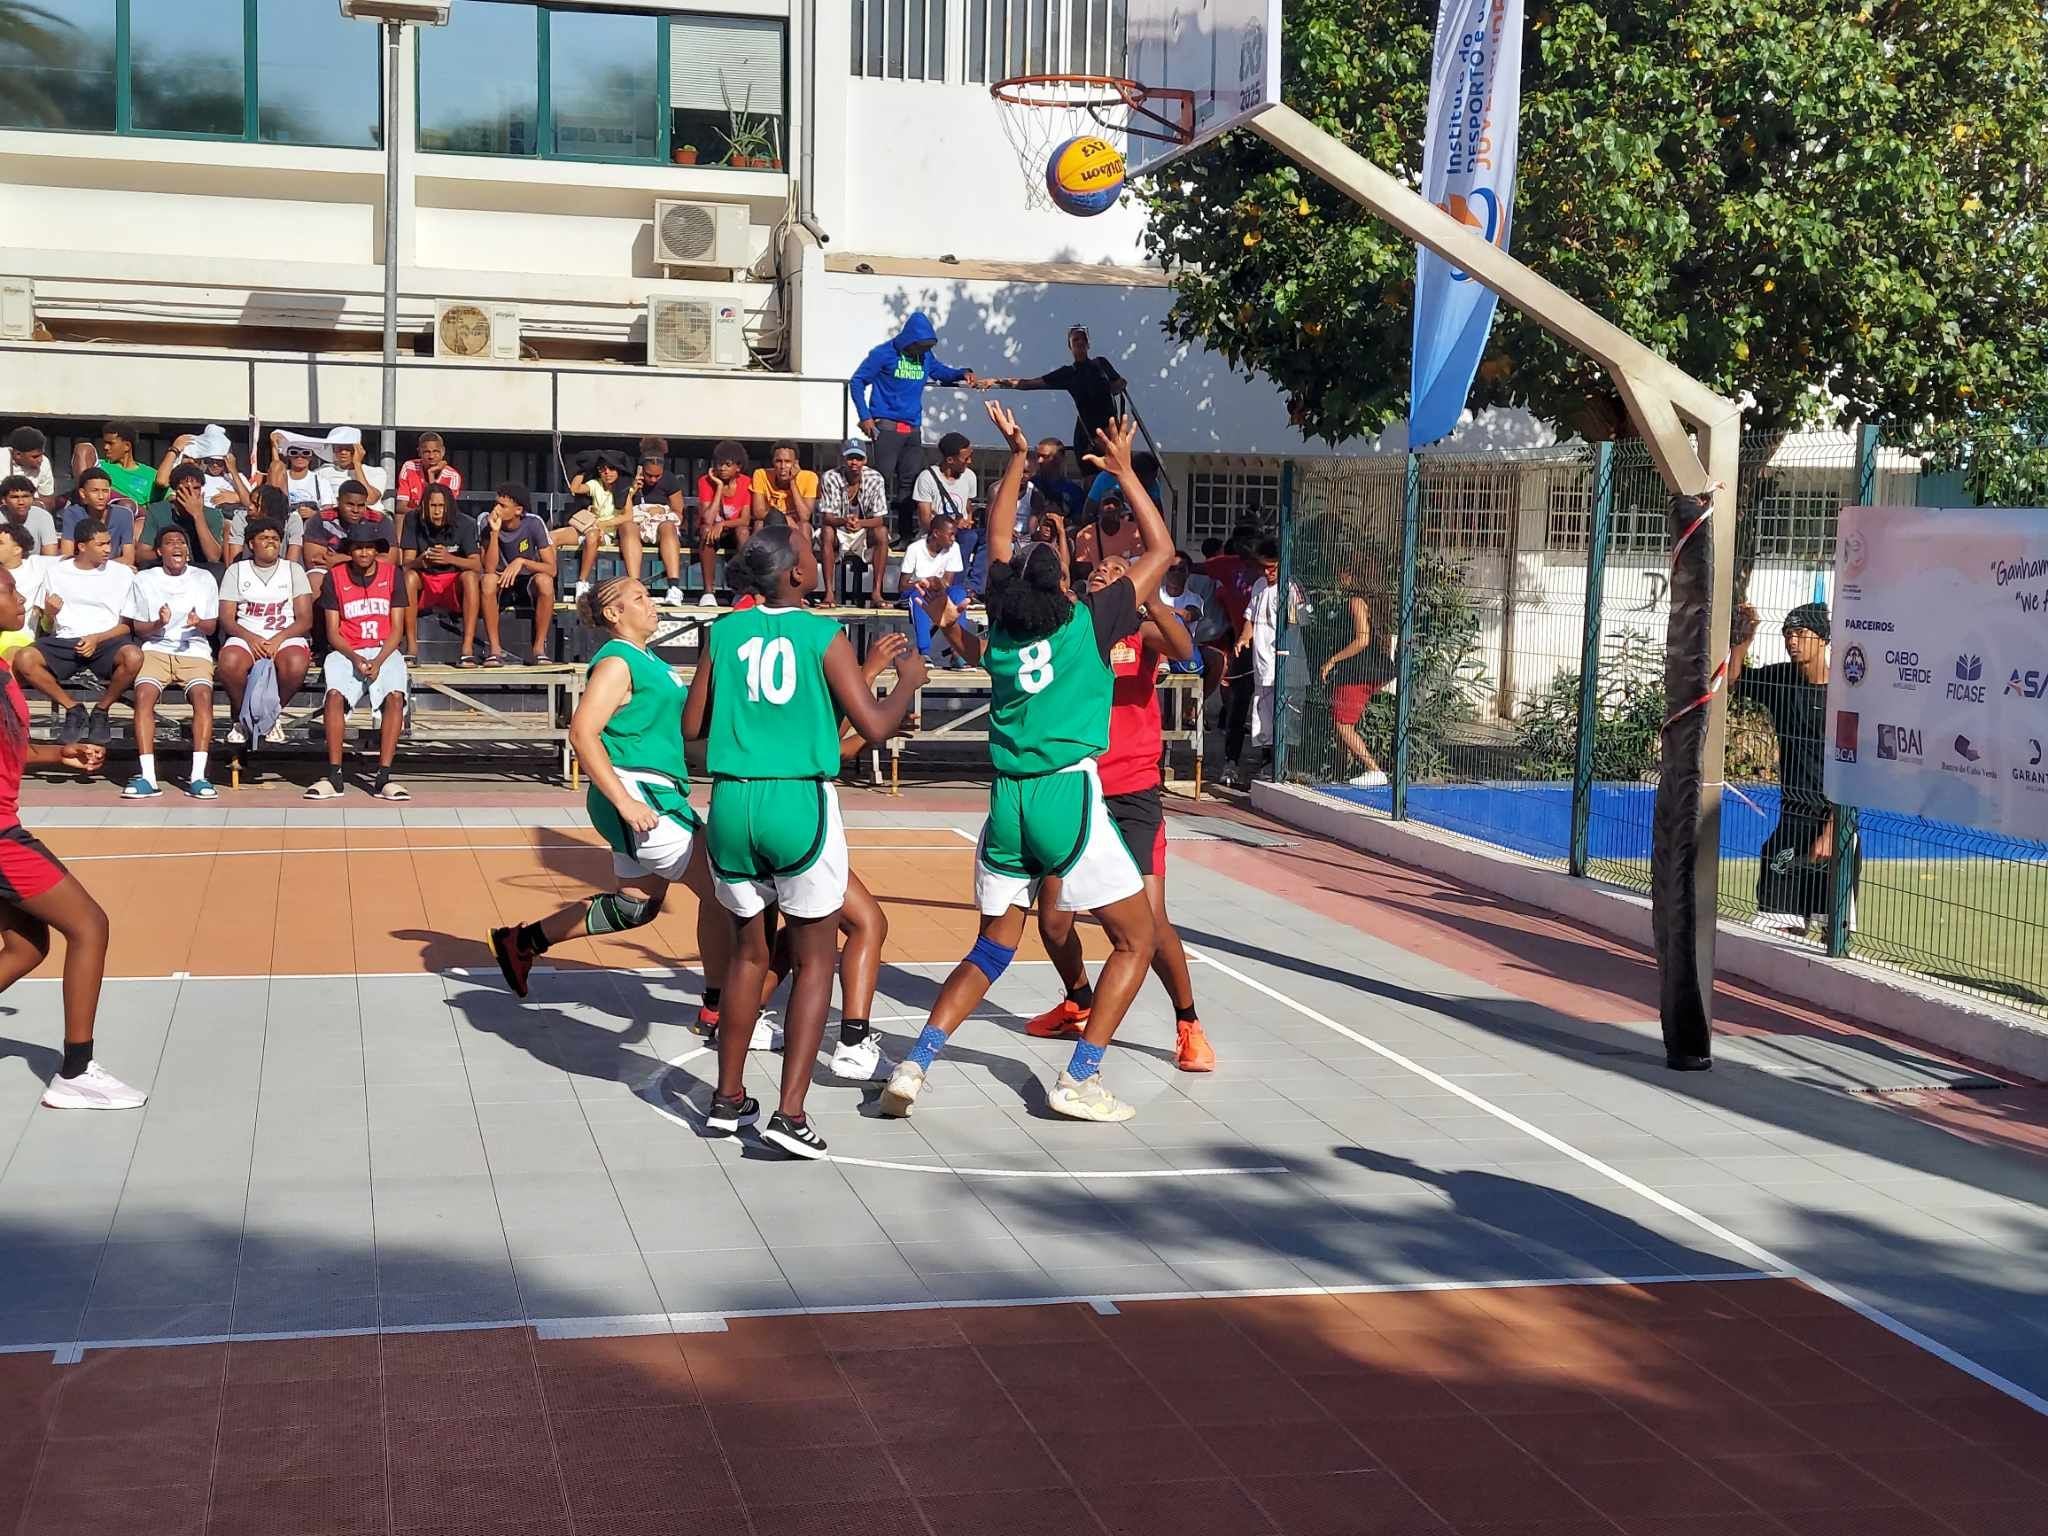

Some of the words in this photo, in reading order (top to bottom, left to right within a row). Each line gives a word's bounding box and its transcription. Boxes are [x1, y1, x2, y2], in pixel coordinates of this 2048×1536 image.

[1467, 50, 1485, 173] DESPORTO
[1081, 159, 1122, 181] Wilson
[245, 601, 285, 617] HEAT
[343, 597, 390, 620] ROCKETS
[263, 615, 287, 631] 22
[1018, 639, 1054, 694] 8
[1885, 650, 1919, 666] CABO
[737, 636, 797, 705] 10
[1898, 667, 1932, 684] VERDE
[1946, 682, 1987, 704] FICASE
[1897, 726, 1924, 757] BAI
[1834, 748, 1855, 762] BCA
